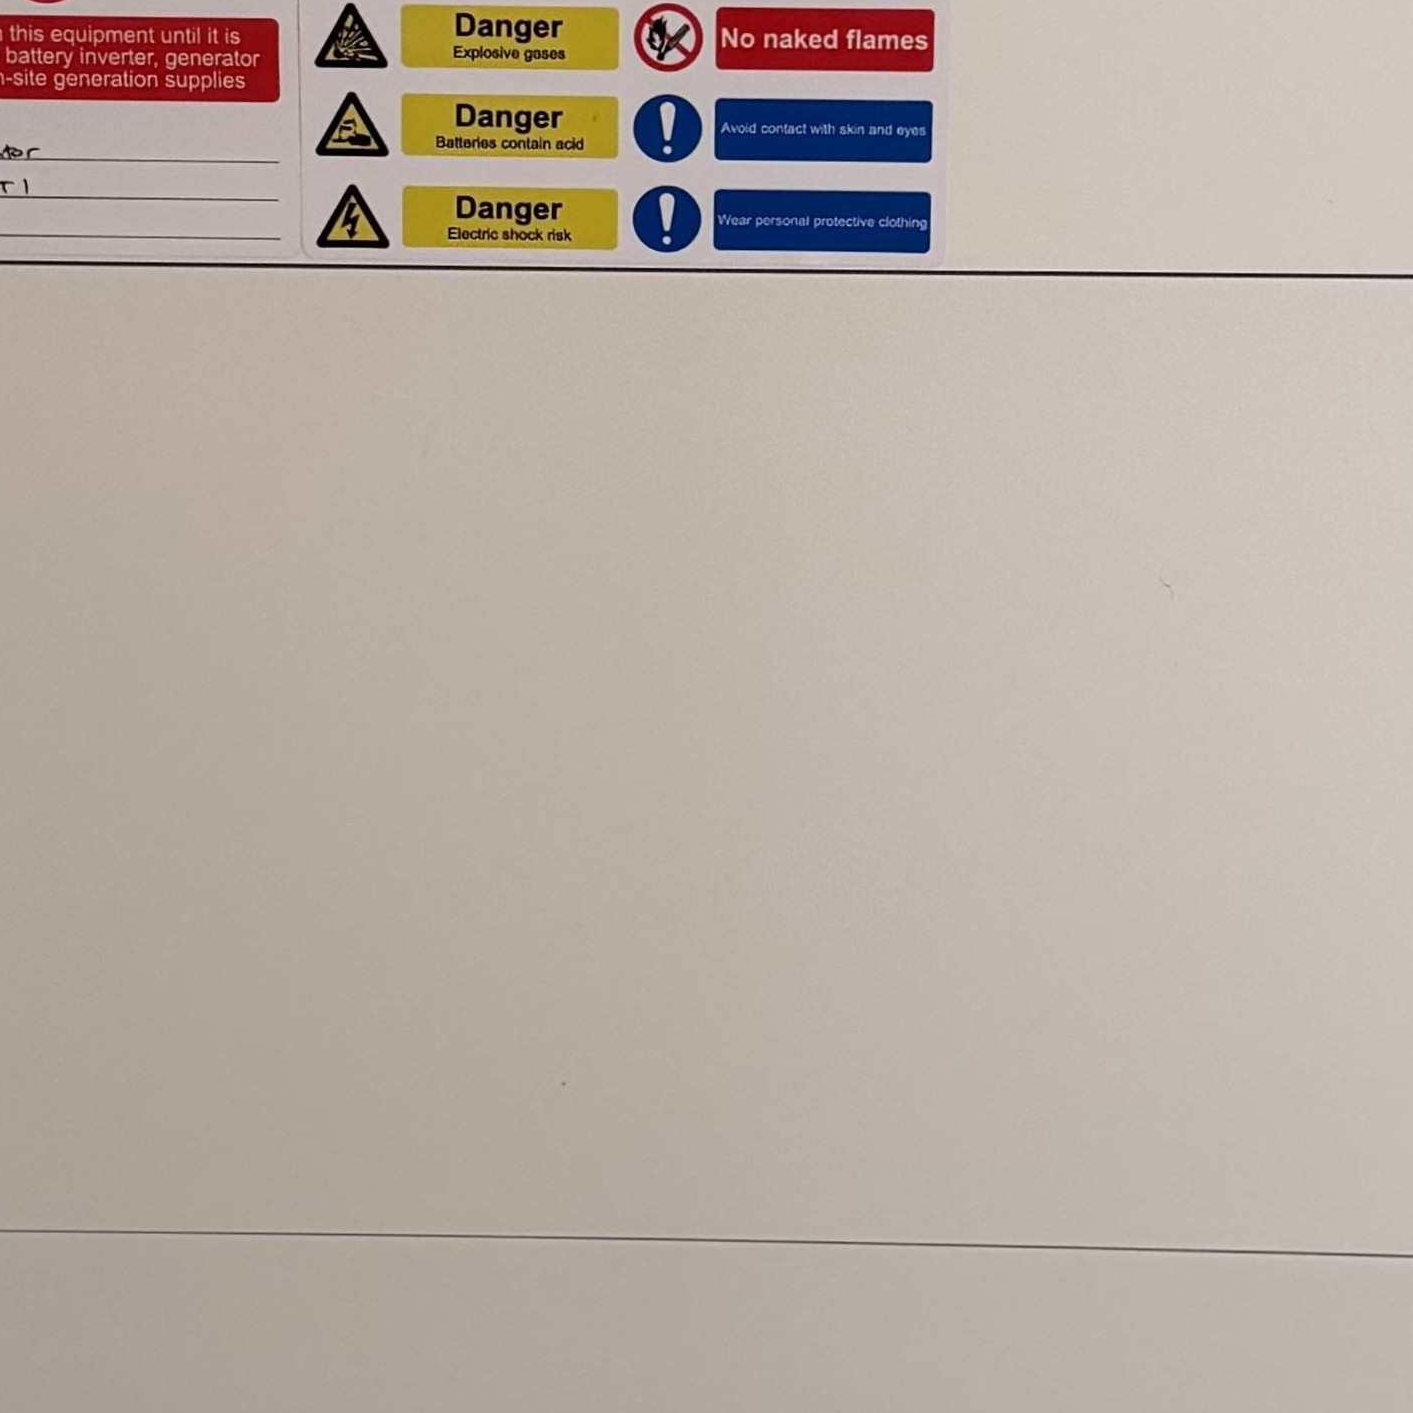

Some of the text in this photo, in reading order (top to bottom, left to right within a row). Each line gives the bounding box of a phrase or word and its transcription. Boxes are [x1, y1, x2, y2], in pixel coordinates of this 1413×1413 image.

[8, 25, 44, 43] this
[51, 26, 155, 47] equipment
[161, 28, 202, 45] until
[207, 28, 220, 45] it
[225, 28, 240, 45] is
[454, 13, 564, 43] Danger
[721, 28, 929, 51] No naked flames
[5, 46, 74, 68] battery
[79, 48, 159, 68] inverter,
[165, 51, 260, 70] generator
[453, 46, 565, 64] Explosive gases
[54, 71, 158, 91] generation
[164, 73, 245, 92] supplies
[454, 103, 564, 132] Danger
[721, 122, 926, 138] Avoid contact with skin and eyes
[435, 135, 585, 151] Batteries contain acid
[455, 196, 563, 226] Danger
[718, 215, 928, 230] Wear personal protective clothing
[447, 227, 572, 242] Electric shock risk
